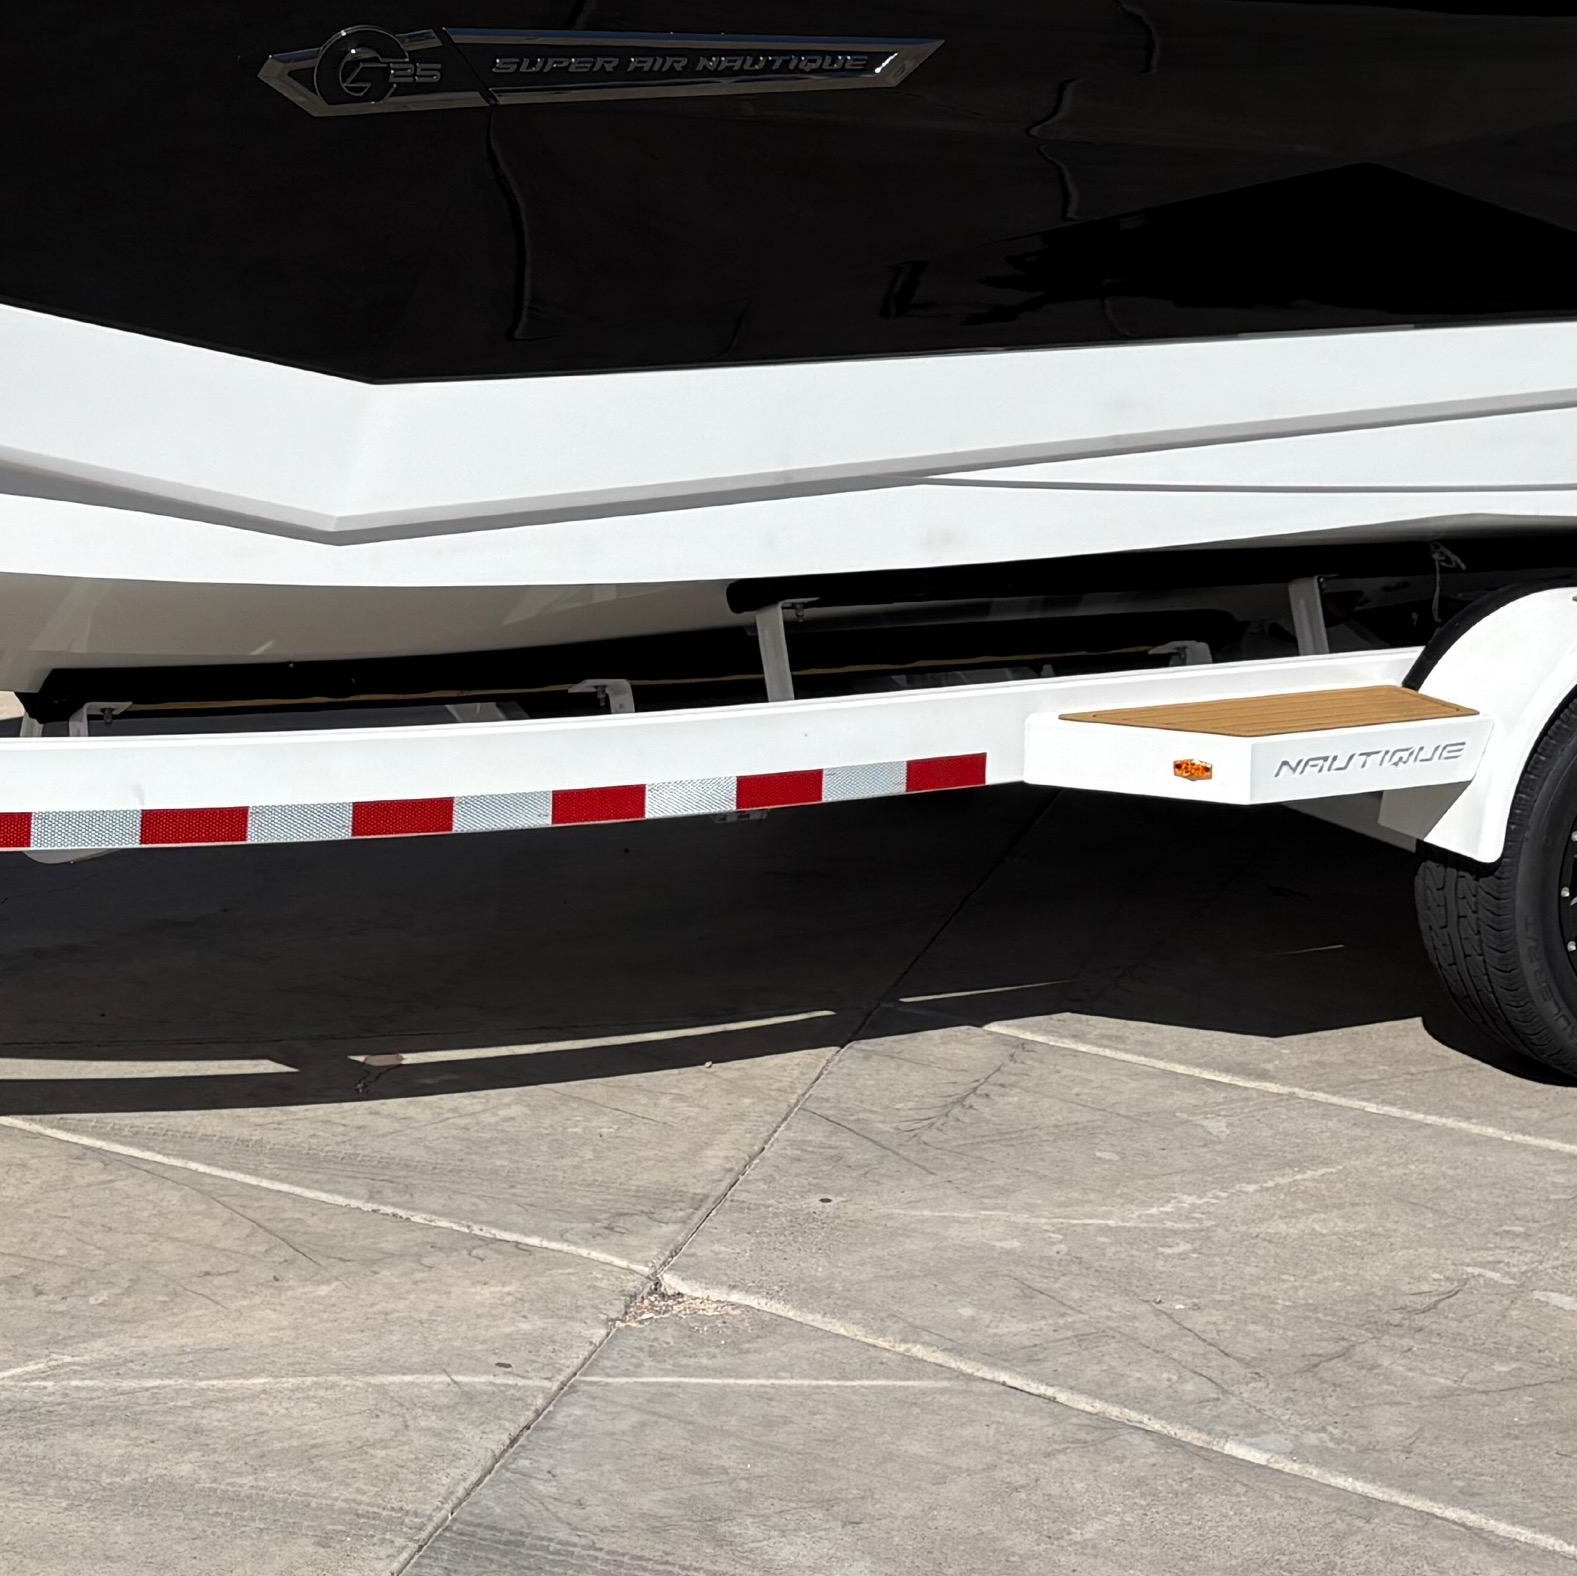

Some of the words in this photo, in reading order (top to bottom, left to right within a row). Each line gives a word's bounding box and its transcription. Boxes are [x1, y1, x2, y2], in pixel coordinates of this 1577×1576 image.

[491, 55, 619, 74] SUPER
[626, 55, 688, 73] AIR
[696, 54, 868, 72] NAUTIQUE
[1274, 741, 1466, 778] NAUTIQUE
